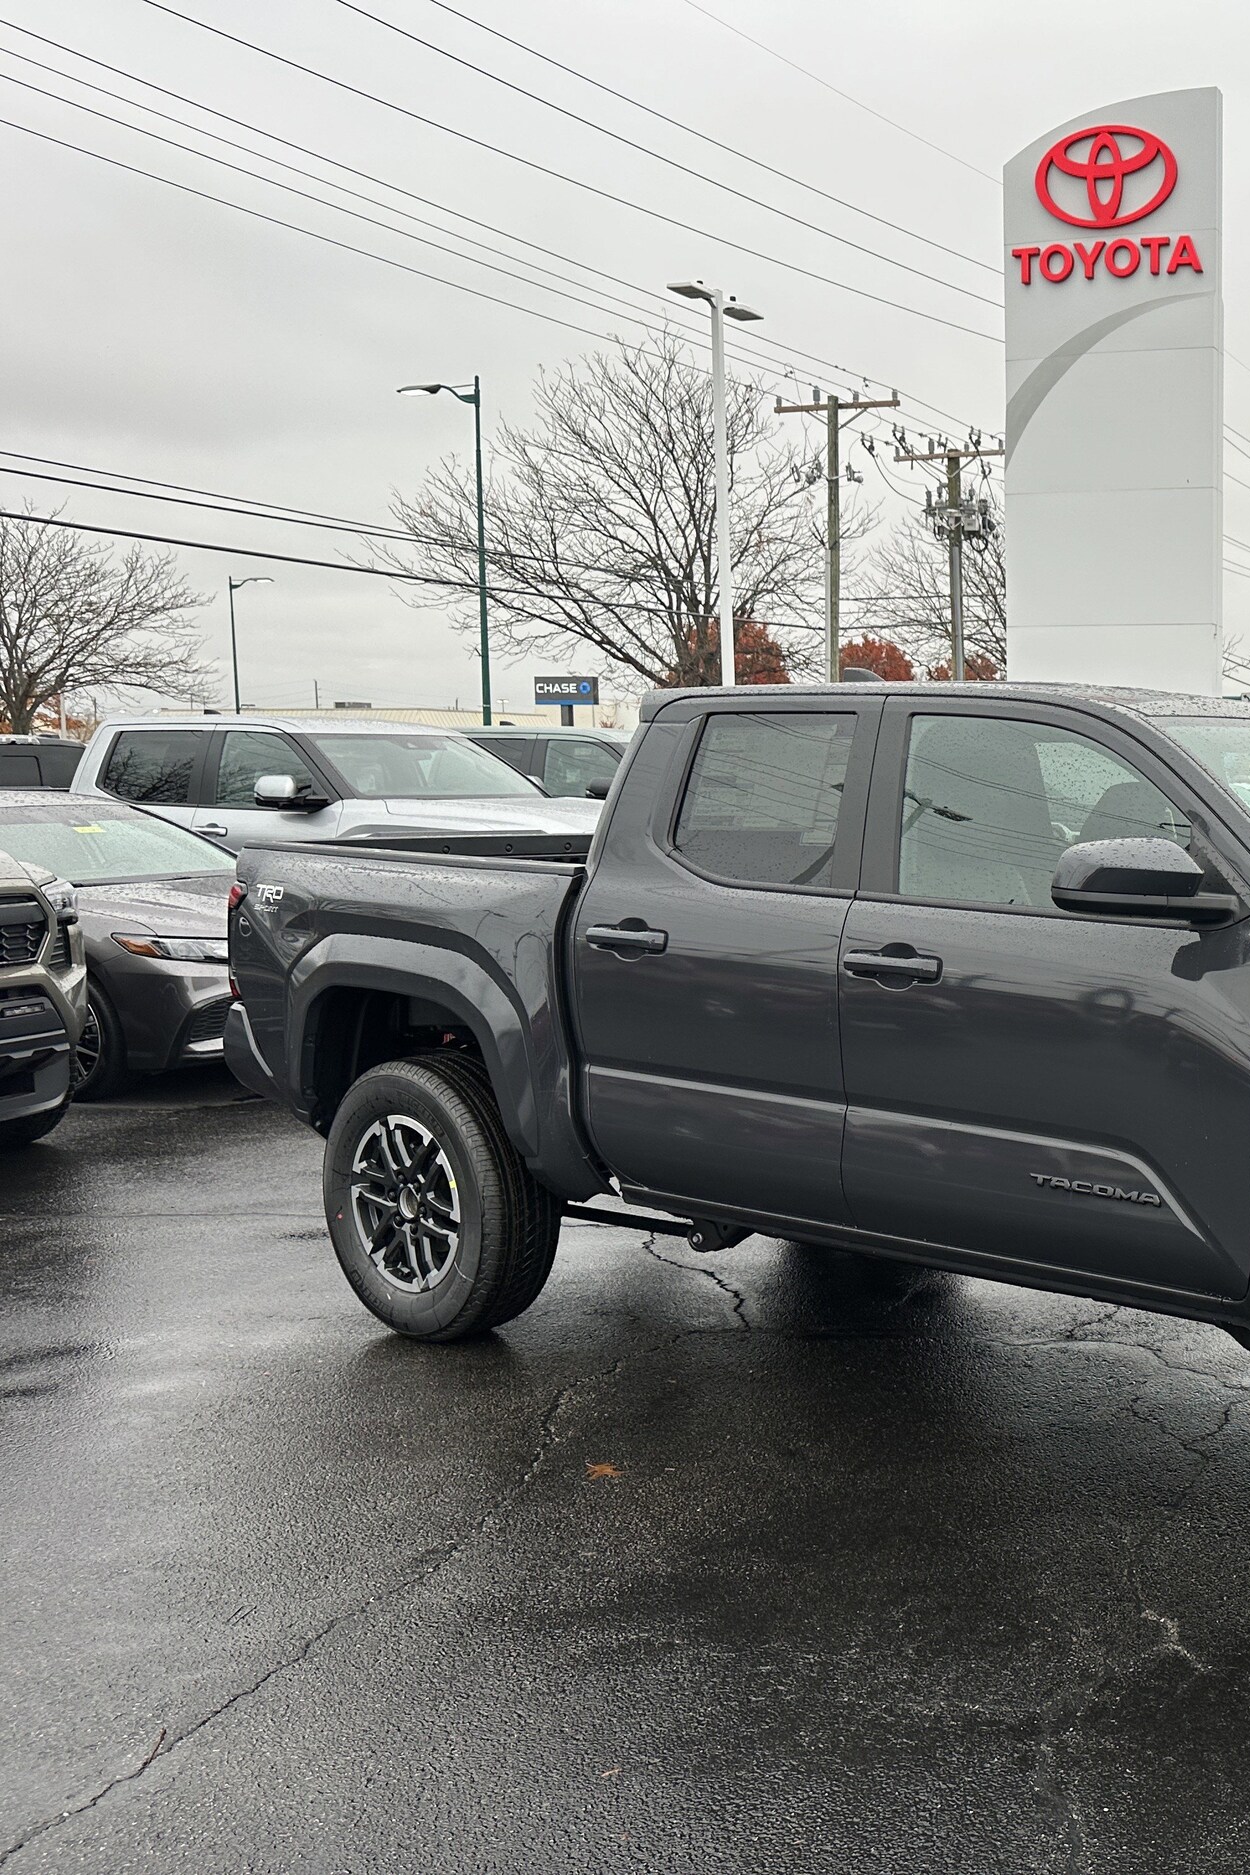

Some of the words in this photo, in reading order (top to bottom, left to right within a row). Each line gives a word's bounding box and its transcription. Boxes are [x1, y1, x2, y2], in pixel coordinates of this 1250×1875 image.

[1012, 235, 1204, 286] TOYOTA
[535, 682, 578, 694] CHASE
[256, 883, 284, 903] TRD
[1029, 1172, 1162, 1206] TACOMA
